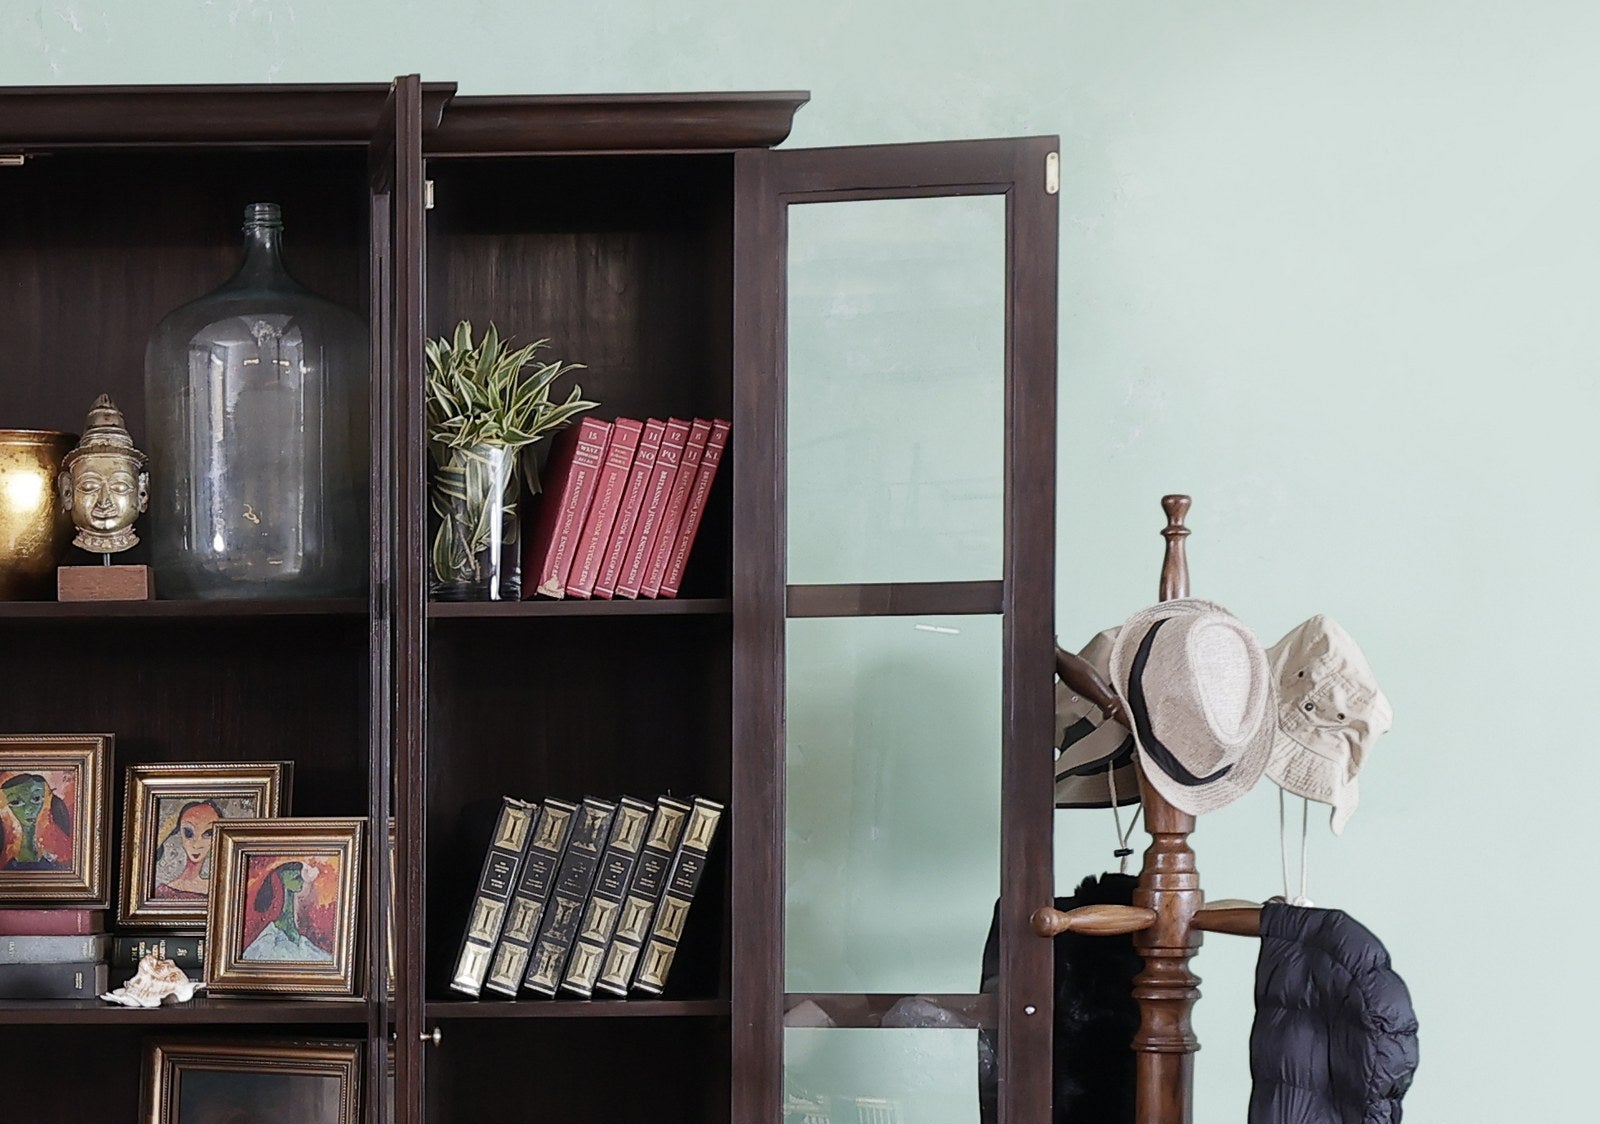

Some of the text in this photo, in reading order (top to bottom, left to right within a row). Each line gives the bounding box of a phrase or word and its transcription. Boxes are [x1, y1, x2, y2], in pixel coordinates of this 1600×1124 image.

[588, 431, 597, 440] 15
[671, 432, 681, 440] 12
[639, 450, 655, 460] NO
[662, 450, 676, 463] PQ
[652, 470, 667, 510] BRITANNICA
[643, 509, 654, 535] JUNIOR
